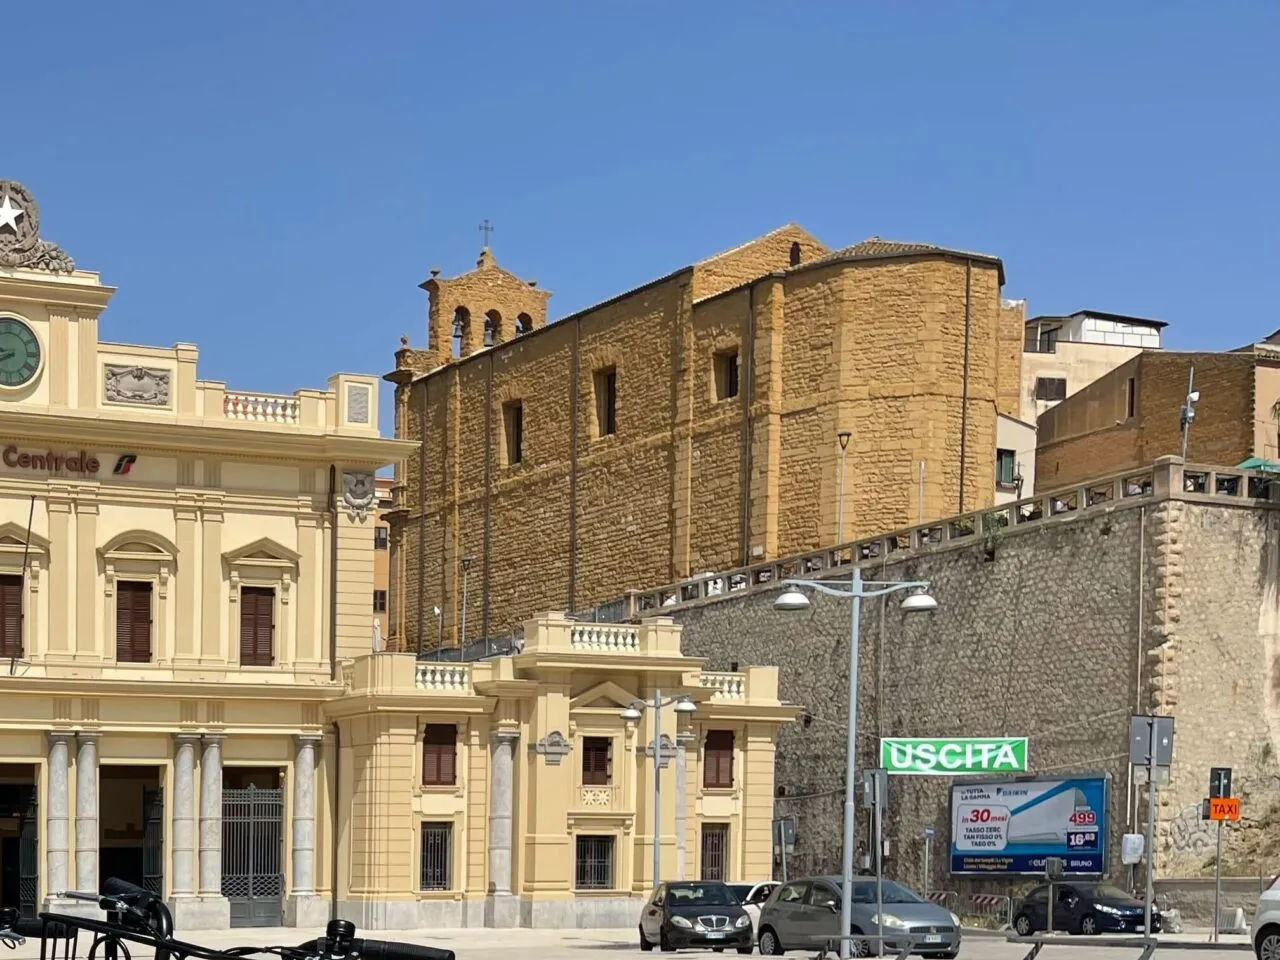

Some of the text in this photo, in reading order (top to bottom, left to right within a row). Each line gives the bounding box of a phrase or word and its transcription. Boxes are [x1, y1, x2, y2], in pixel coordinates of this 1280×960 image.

[2, 444, 101, 473] Centrale
[890, 743, 1019, 769] USCITA
[969, 808, 991, 823] 30
[990, 813, 1008, 822] mesi
[1213, 804, 1237, 815] TAXI
[1069, 812, 1096, 824] 499
